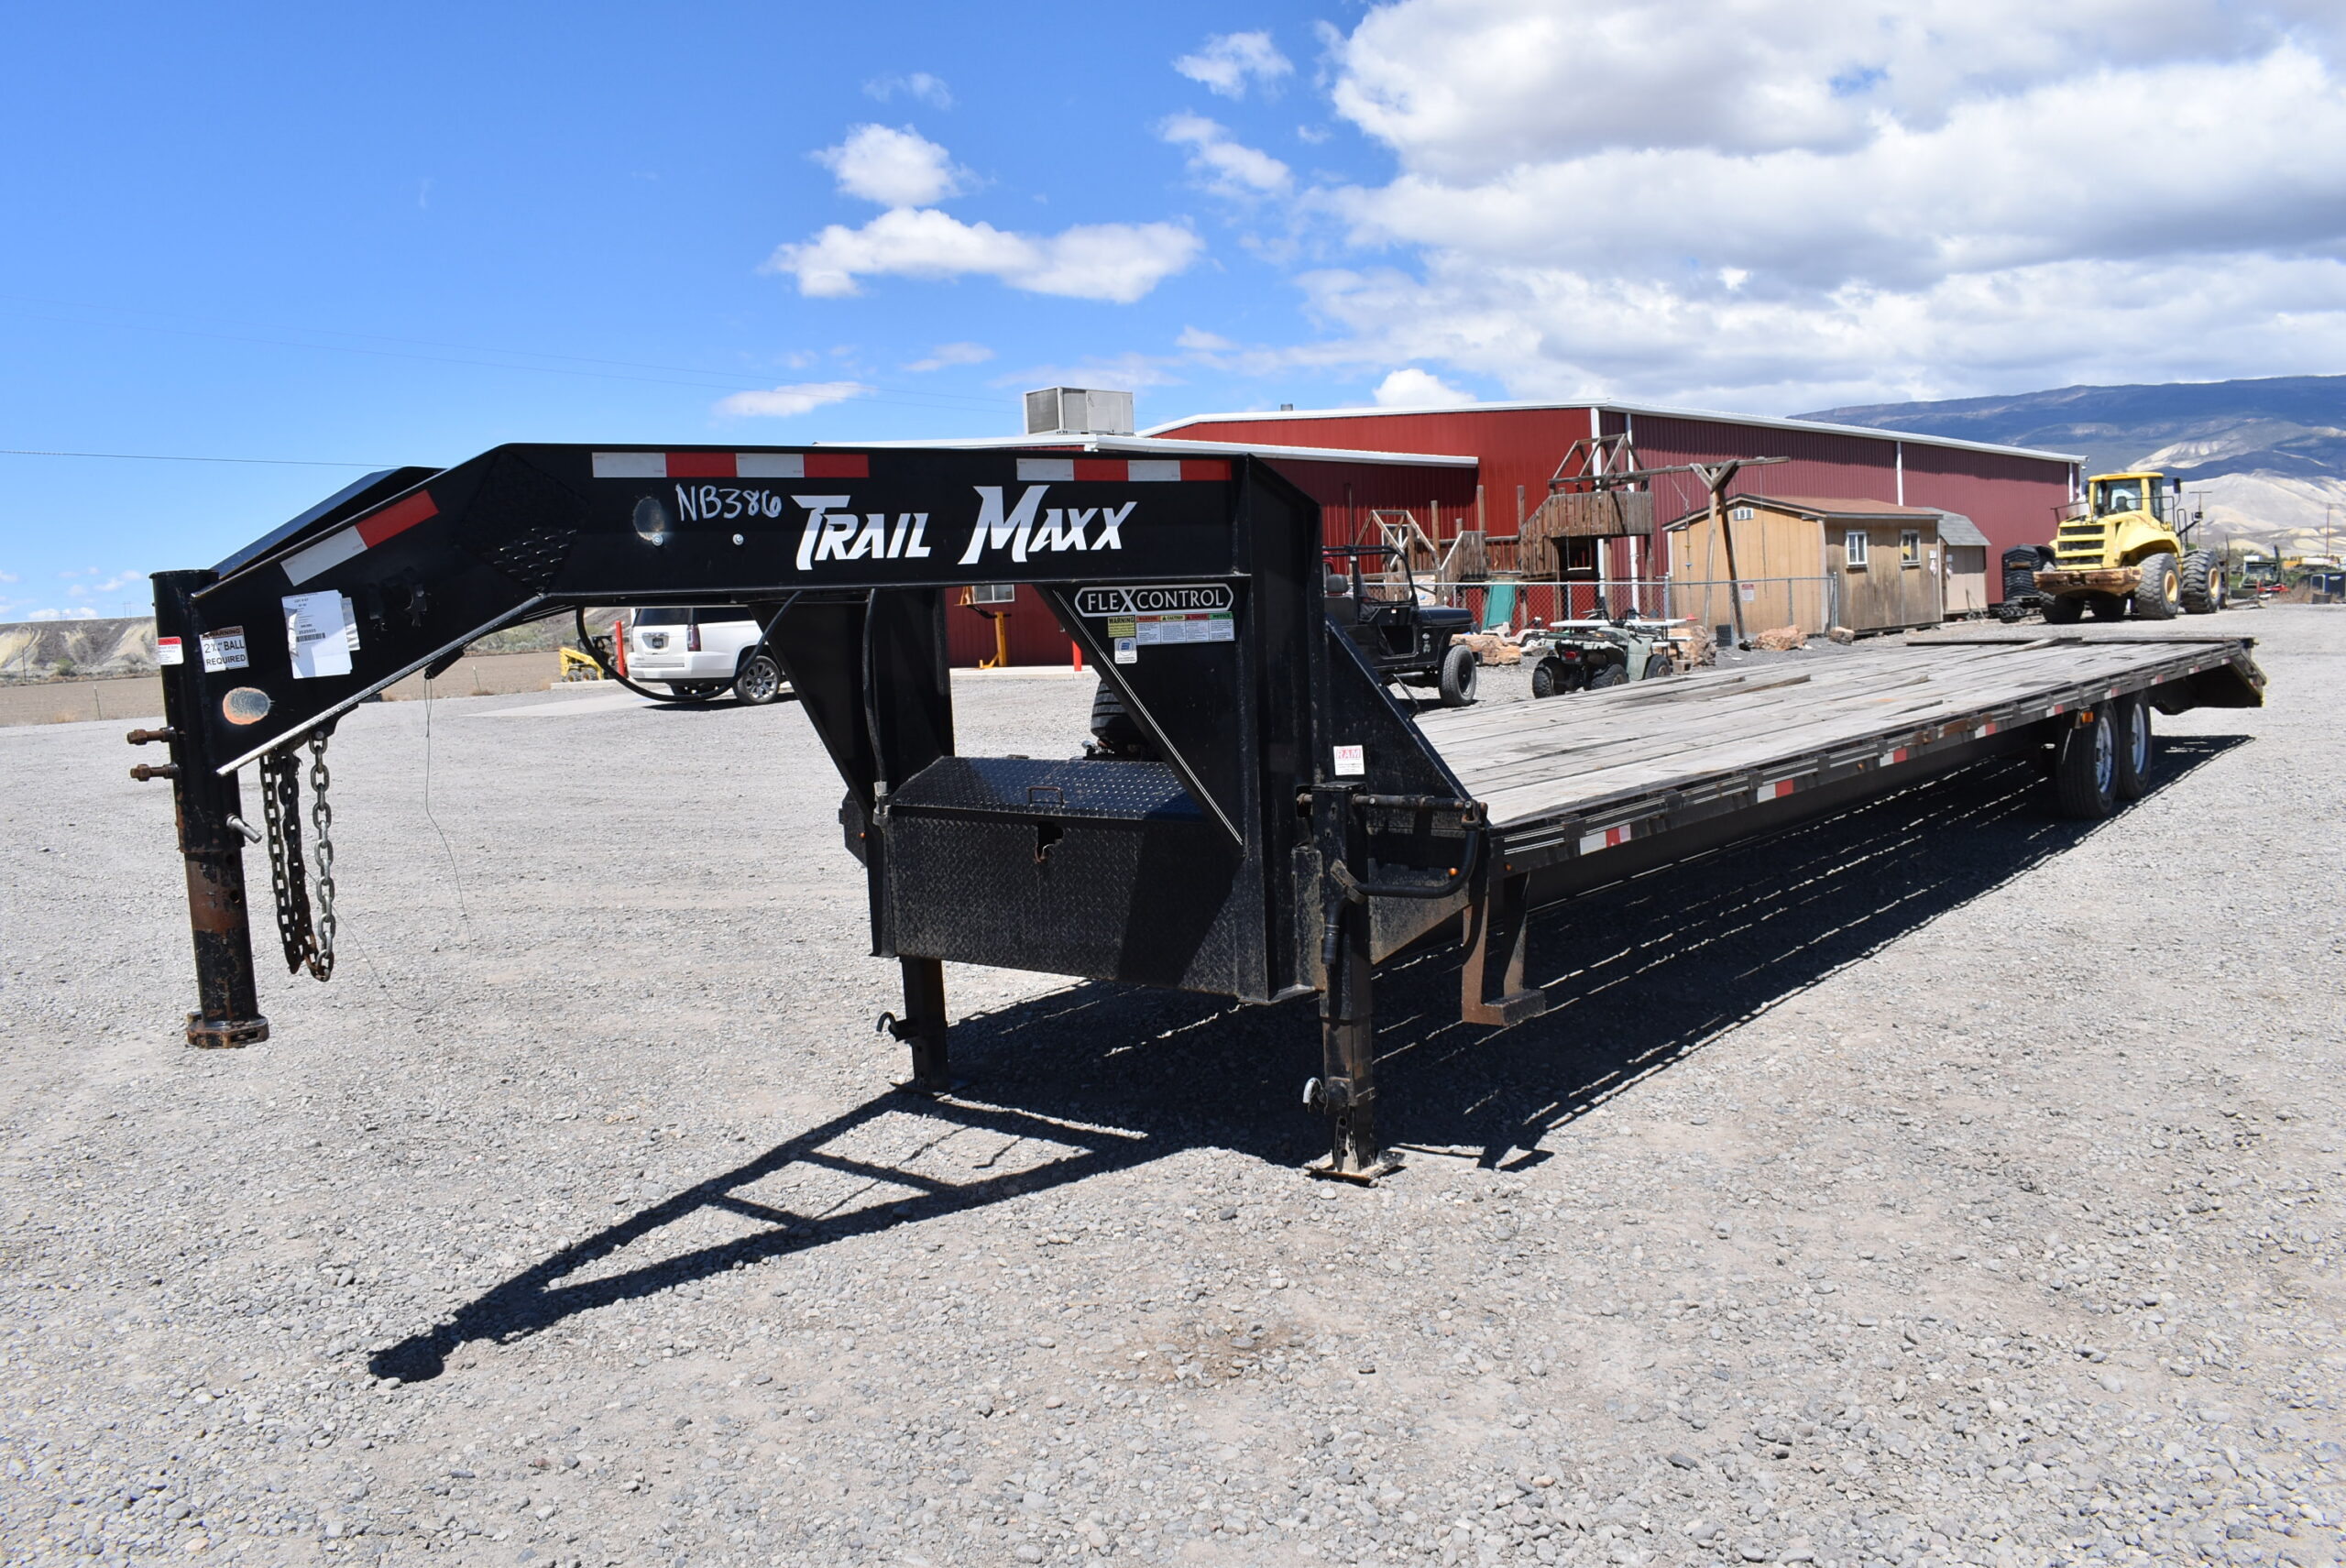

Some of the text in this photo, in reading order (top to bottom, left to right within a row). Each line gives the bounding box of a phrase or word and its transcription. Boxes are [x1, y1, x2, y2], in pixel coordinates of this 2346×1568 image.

[675, 483, 782, 521] NB386
[224, 641, 246, 651] BALL
[206, 654, 247, 666] REQUIRED
